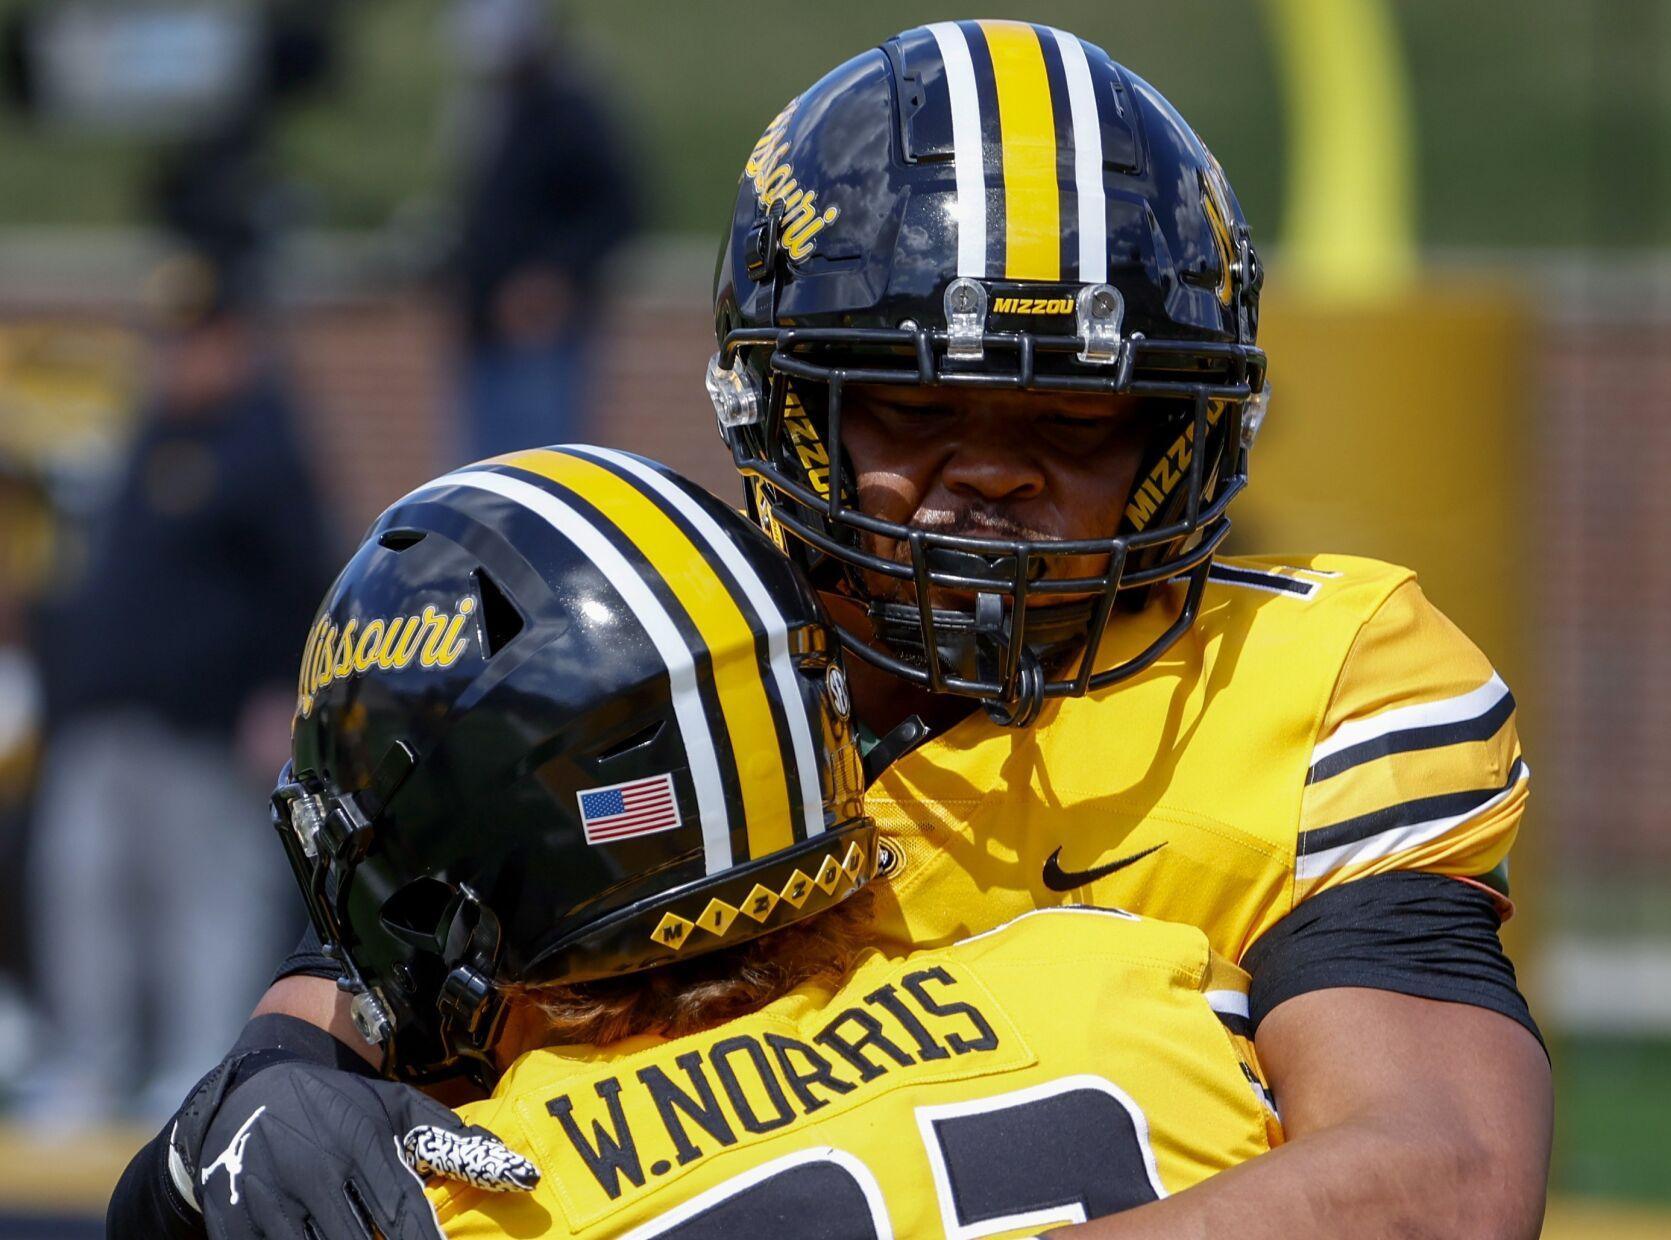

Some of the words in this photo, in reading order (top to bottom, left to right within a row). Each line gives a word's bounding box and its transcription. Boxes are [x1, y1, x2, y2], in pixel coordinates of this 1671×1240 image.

[745, 97, 840, 260] ssouri
[993, 297, 1074, 314] MIZZOU
[661, 851, 861, 943] MIZZOU
[545, 966, 999, 1200] W.NORRIS
